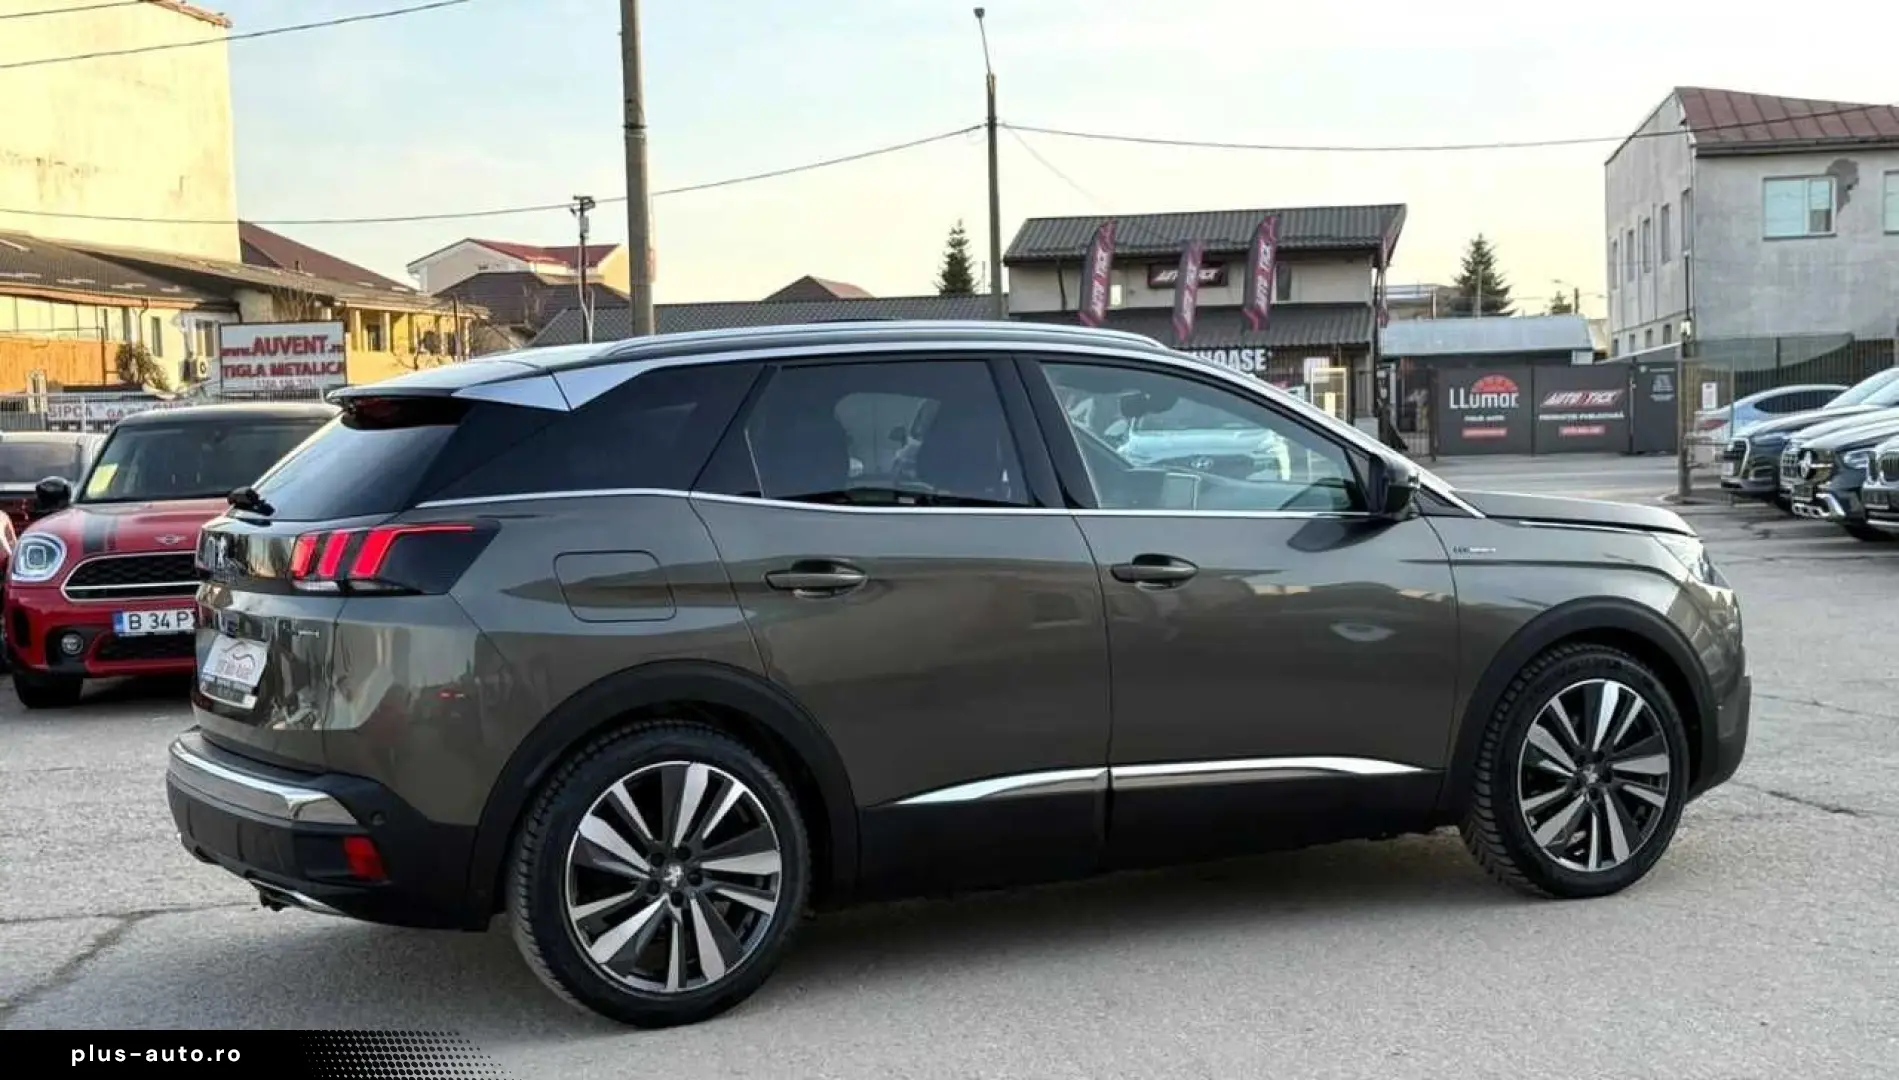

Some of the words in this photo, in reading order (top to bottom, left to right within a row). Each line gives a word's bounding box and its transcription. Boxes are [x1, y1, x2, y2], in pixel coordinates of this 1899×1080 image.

[222, 363, 267, 378] TIGLA
[128, 613, 142, 630] B
[149, 612, 170, 629] 34
[176, 611, 197, 629] P
